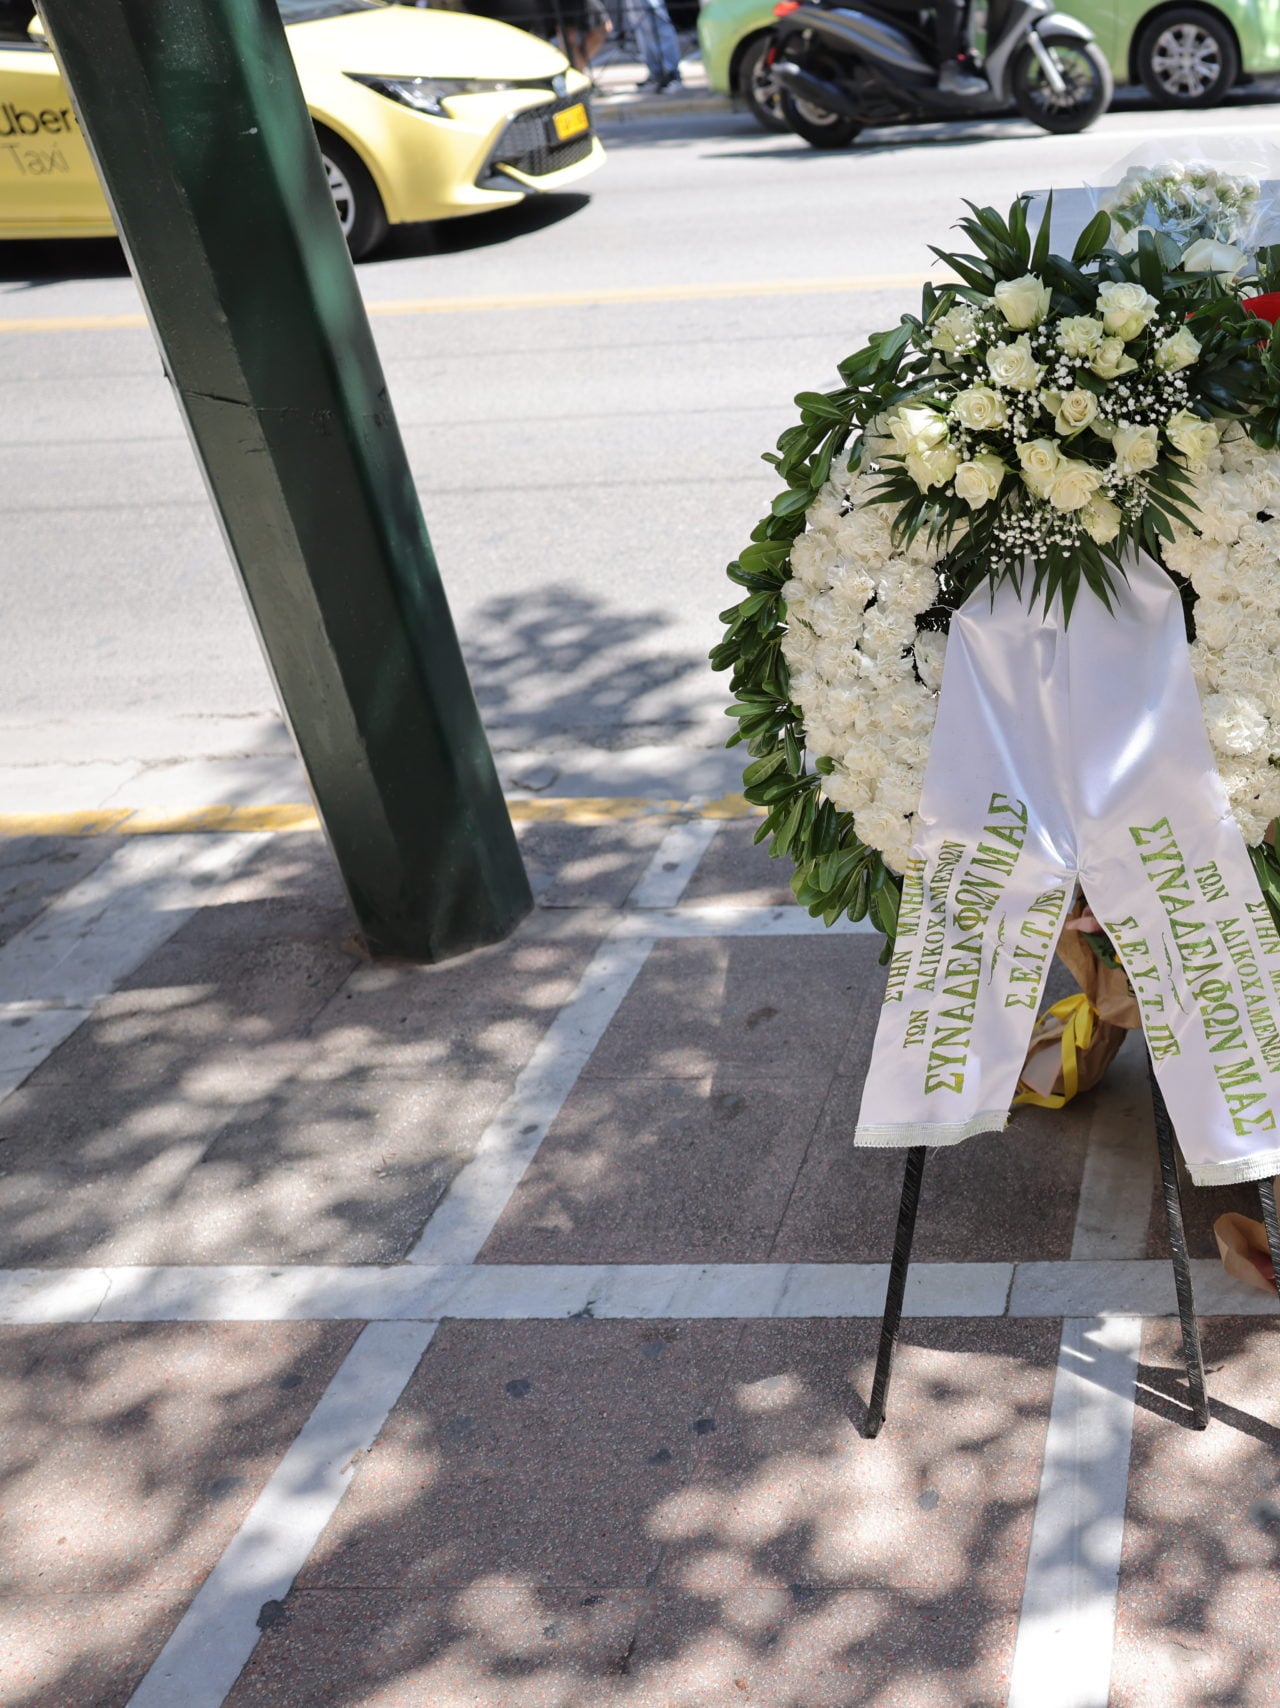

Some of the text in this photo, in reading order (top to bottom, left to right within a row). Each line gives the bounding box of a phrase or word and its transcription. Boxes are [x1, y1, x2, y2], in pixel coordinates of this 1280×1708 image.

[0, 141, 70, 176] Taxi
[897, 857, 928, 937] ΜΝΗΜΗ
[903, 839, 966, 1049] ΤΩΝ ΑΔΙΚΟΧΑΜΕΝΩΝ
[924, 792, 1029, 1095] ΣΥΝΑΔΕΛΦΩΝ ΜΑΣ
[1194, 860, 1230, 902] ΤΩΝ
[1128, 816, 1277, 1137] ΣΥΝΑΔΕΛΦΩΝ ΜΑΣ
